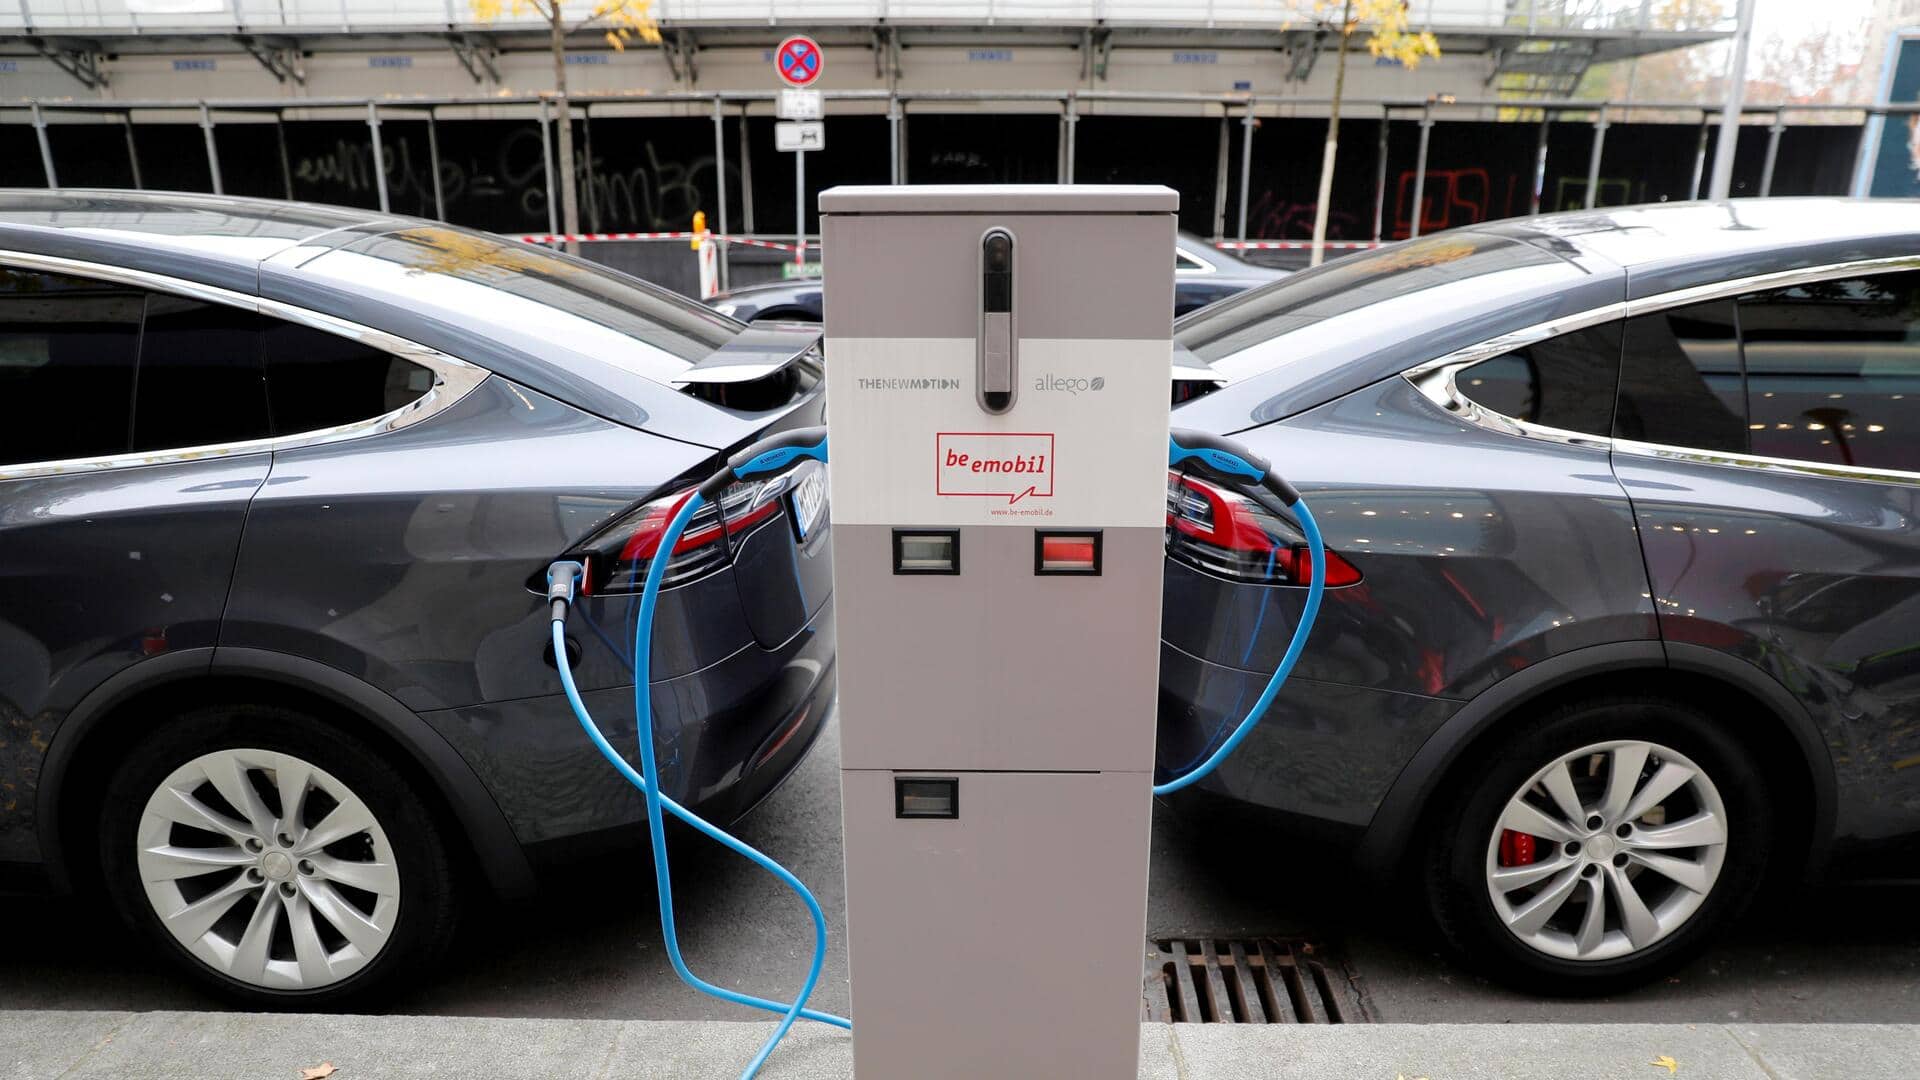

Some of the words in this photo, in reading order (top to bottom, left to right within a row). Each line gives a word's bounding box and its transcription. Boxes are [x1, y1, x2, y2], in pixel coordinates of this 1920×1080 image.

[1035, 373, 1089, 395] allego
[946, 448, 969, 467] be
[971, 455, 1045, 473] emobil
[991, 508, 1053, 516] www.be-emobil.de
